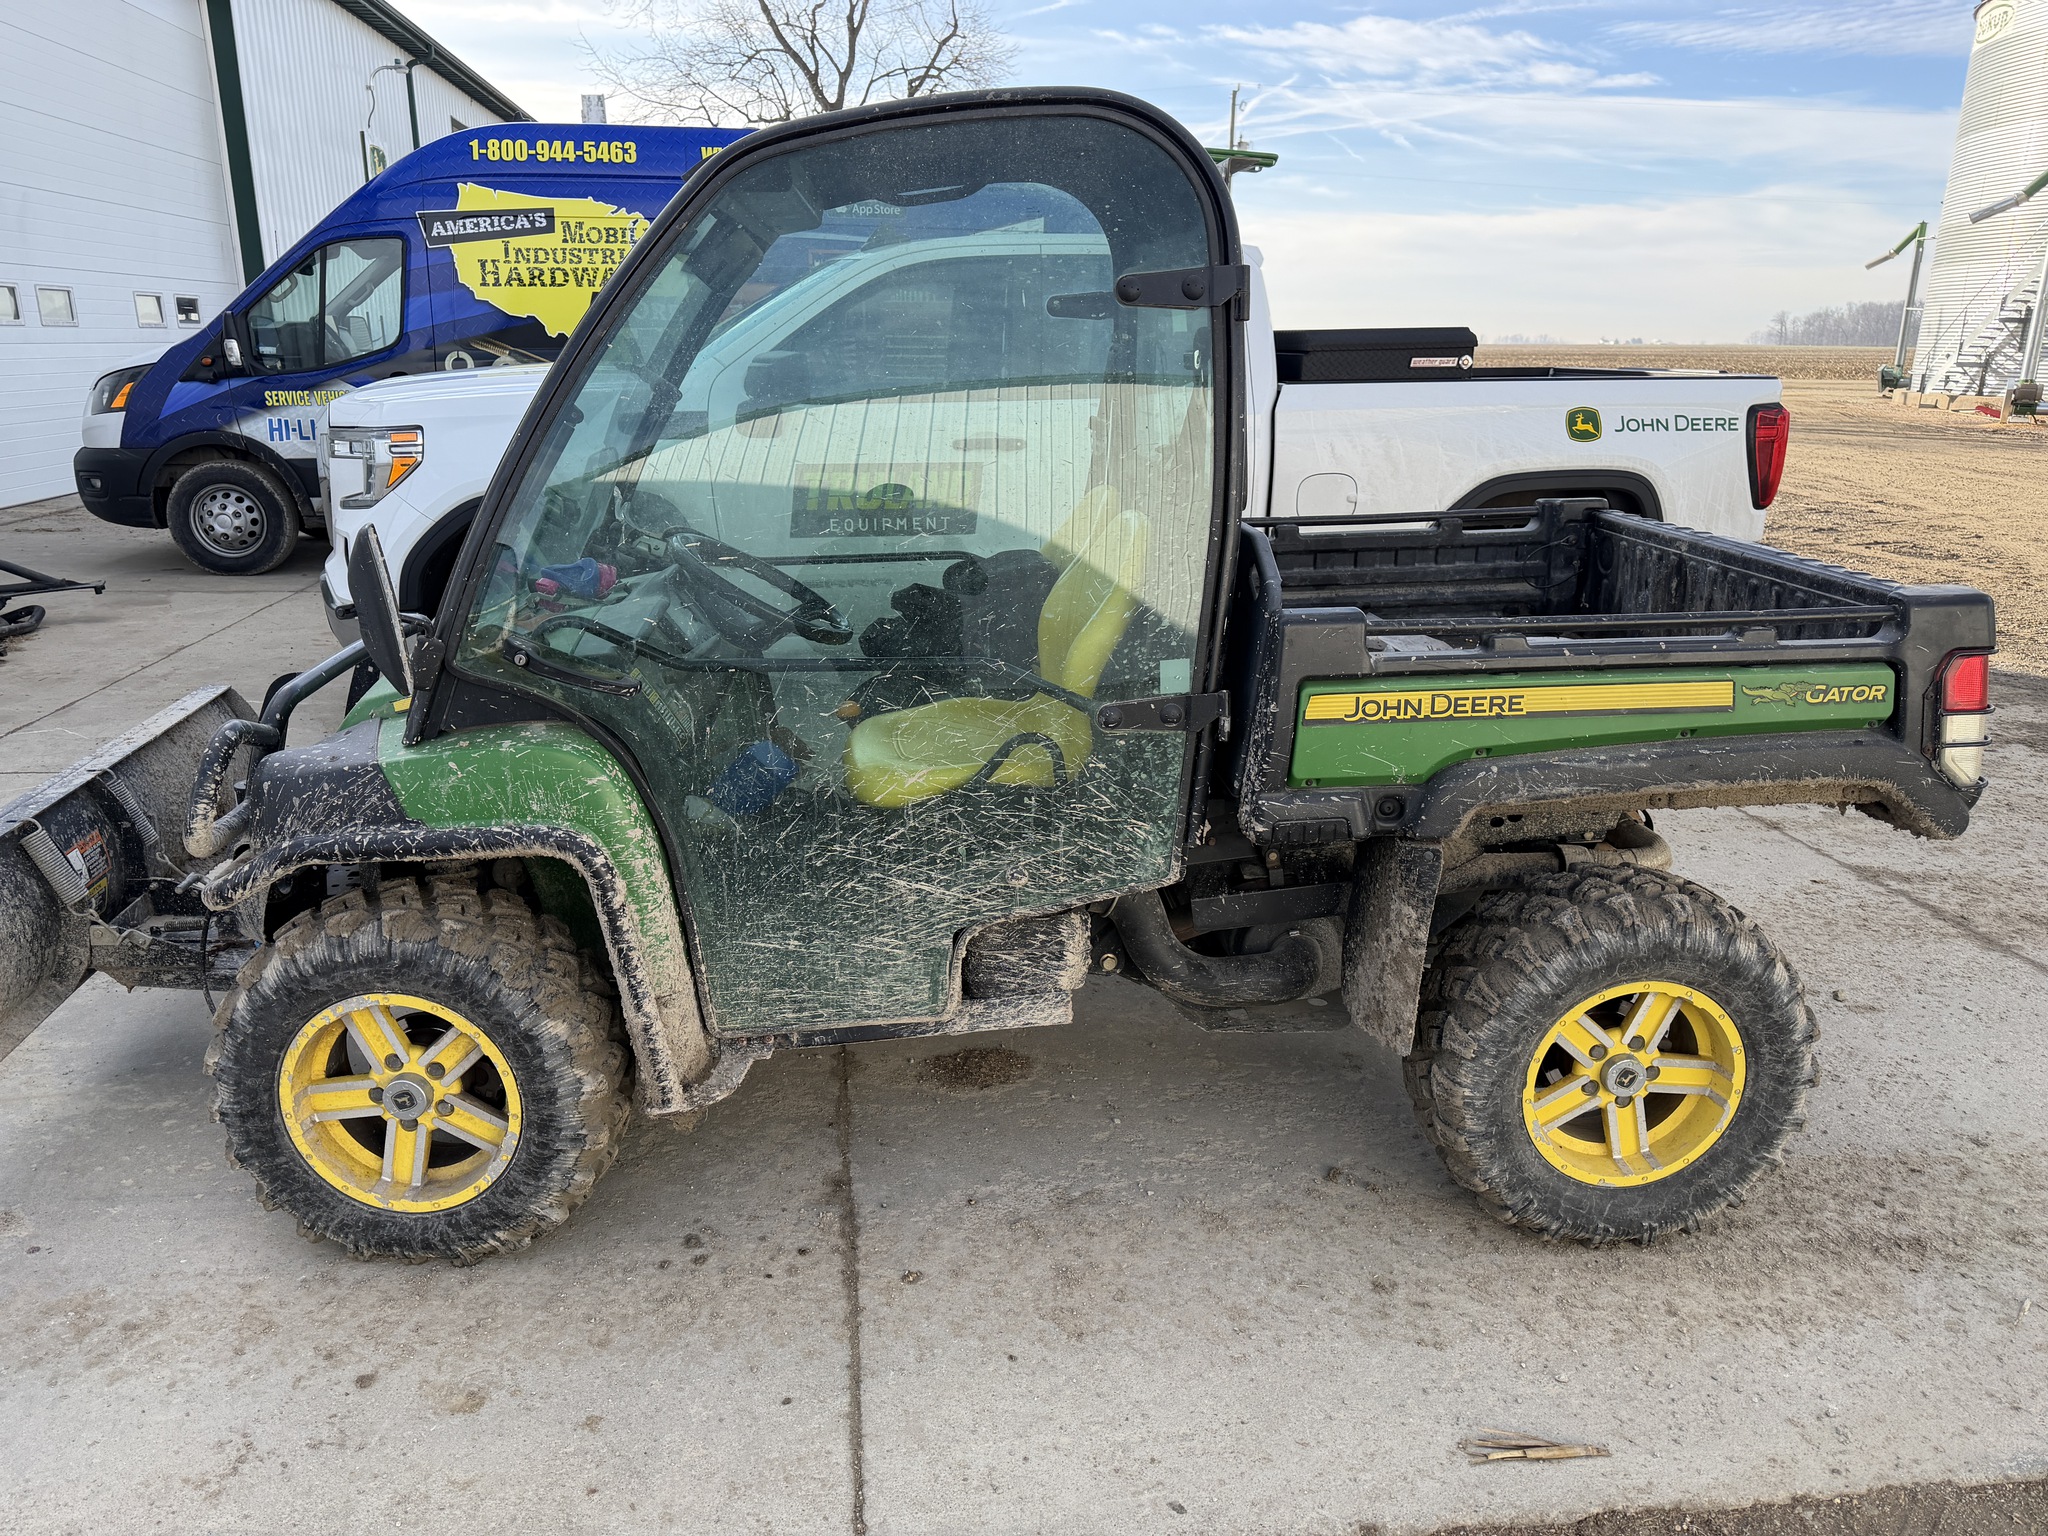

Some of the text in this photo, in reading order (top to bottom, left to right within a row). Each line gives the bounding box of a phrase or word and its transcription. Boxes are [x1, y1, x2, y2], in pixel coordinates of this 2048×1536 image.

[469, 138, 637, 163] 1-800-944-5463
[852, 204, 901, 216] App Store
[431, 212, 548, 237] AMERICA'S
[264, 390, 312, 406] SERVICE
[1614, 414, 1739, 432] JOHN DEERE
[829, 516, 951, 533] EQUIPMENT
[1805, 684, 1887, 703] GATOR
[1343, 693, 1525, 719] JOHN DEERE
